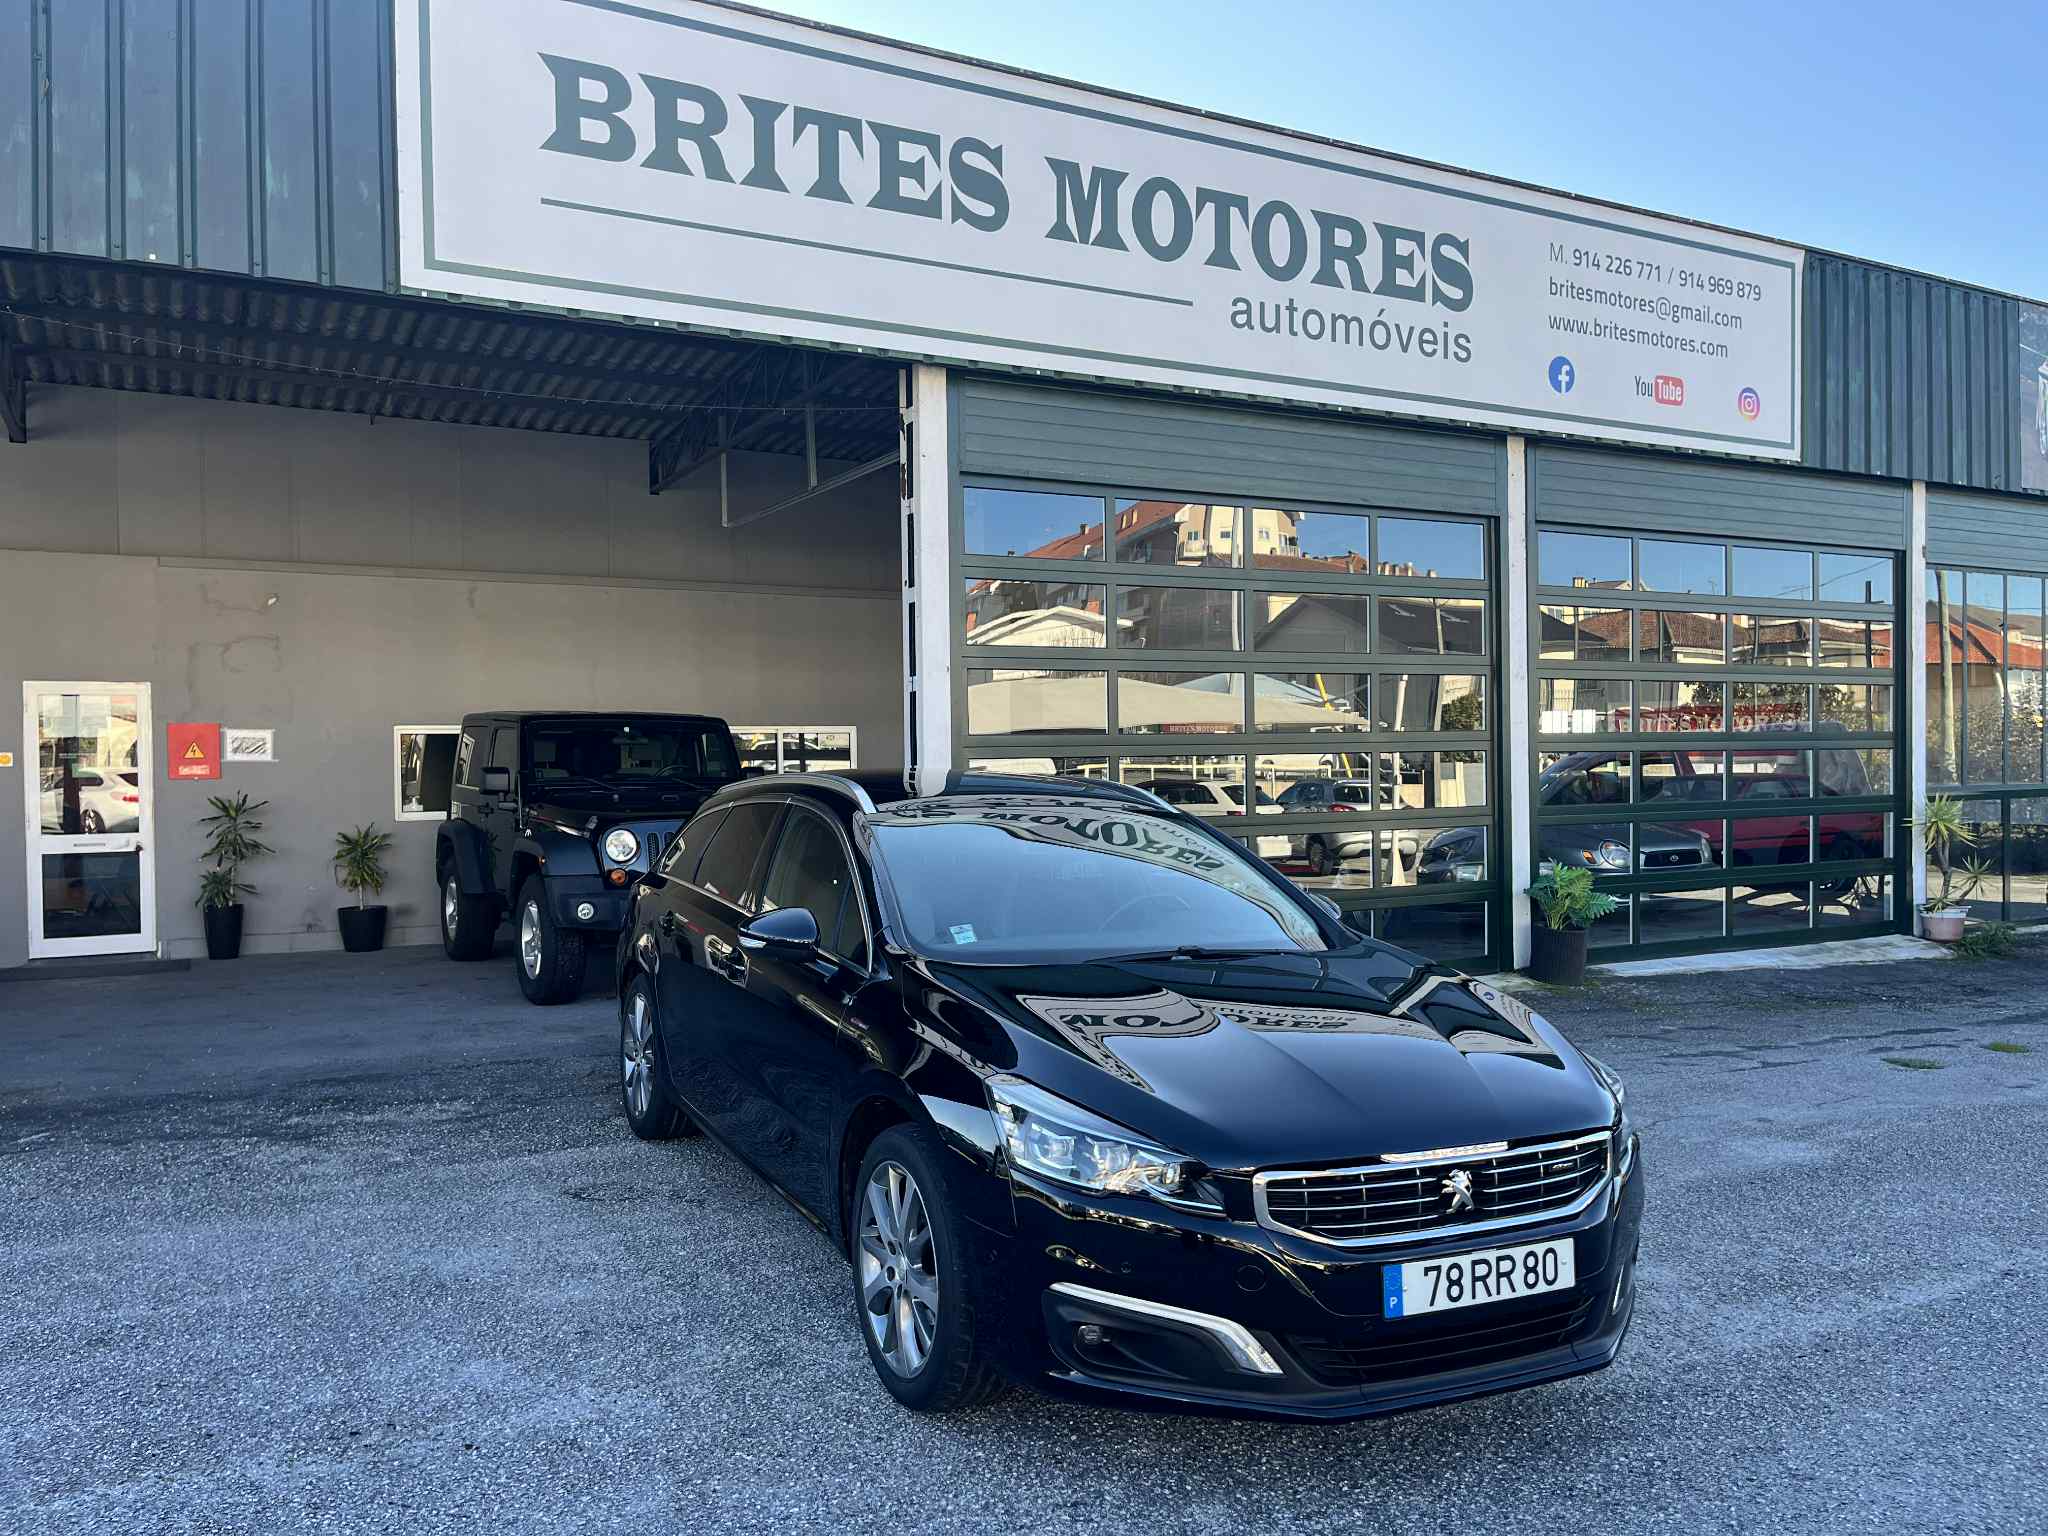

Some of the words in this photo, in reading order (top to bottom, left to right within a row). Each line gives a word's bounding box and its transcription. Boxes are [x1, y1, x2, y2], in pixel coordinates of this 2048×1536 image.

[537, 52, 1010, 232] BRITES
[1044, 156, 1474, 313] MOTORES
[1549, 242, 1568, 264] M.
[1573, 248, 1600, 271] 914
[1605, 255, 1632, 276] 226
[1637, 261, 1661, 282] 771
[1679, 270, 1704, 291] 914
[1708, 276, 1733, 296] 969
[1736, 282, 1761, 301] 879
[1230, 296, 1472, 363] automóveis
[1549, 276, 1743, 330] britesmotores@gmail.com
[1549, 314, 1728, 358] www.britesmotores.com
